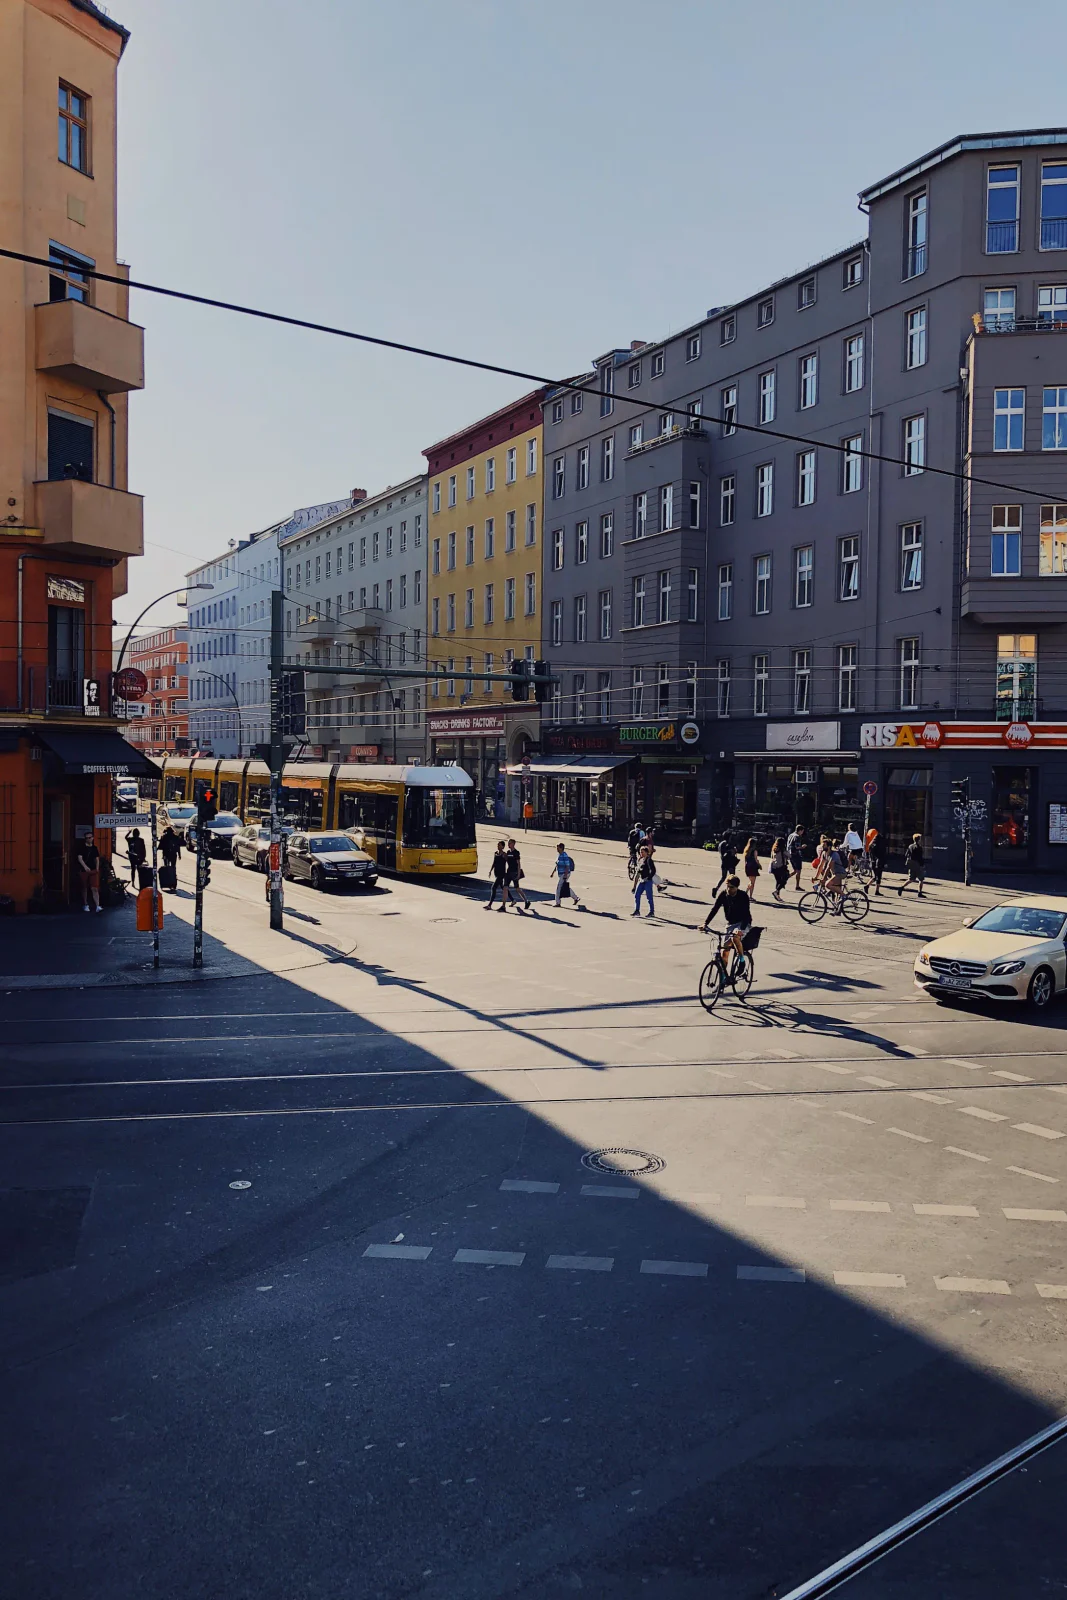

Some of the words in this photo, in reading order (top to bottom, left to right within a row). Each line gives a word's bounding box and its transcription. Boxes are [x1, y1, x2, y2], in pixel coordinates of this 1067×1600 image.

[430, 719, 448, 730] SNACKS
[450, 718, 471, 729] DRINKS
[472, 716, 497, 728] FACTORY
[619, 726, 659, 740] BURGER
[861, 725, 917, 747] RISA
[87, 765, 106, 773] COFFEE
[98, 816, 146, 826] Pappelallee
